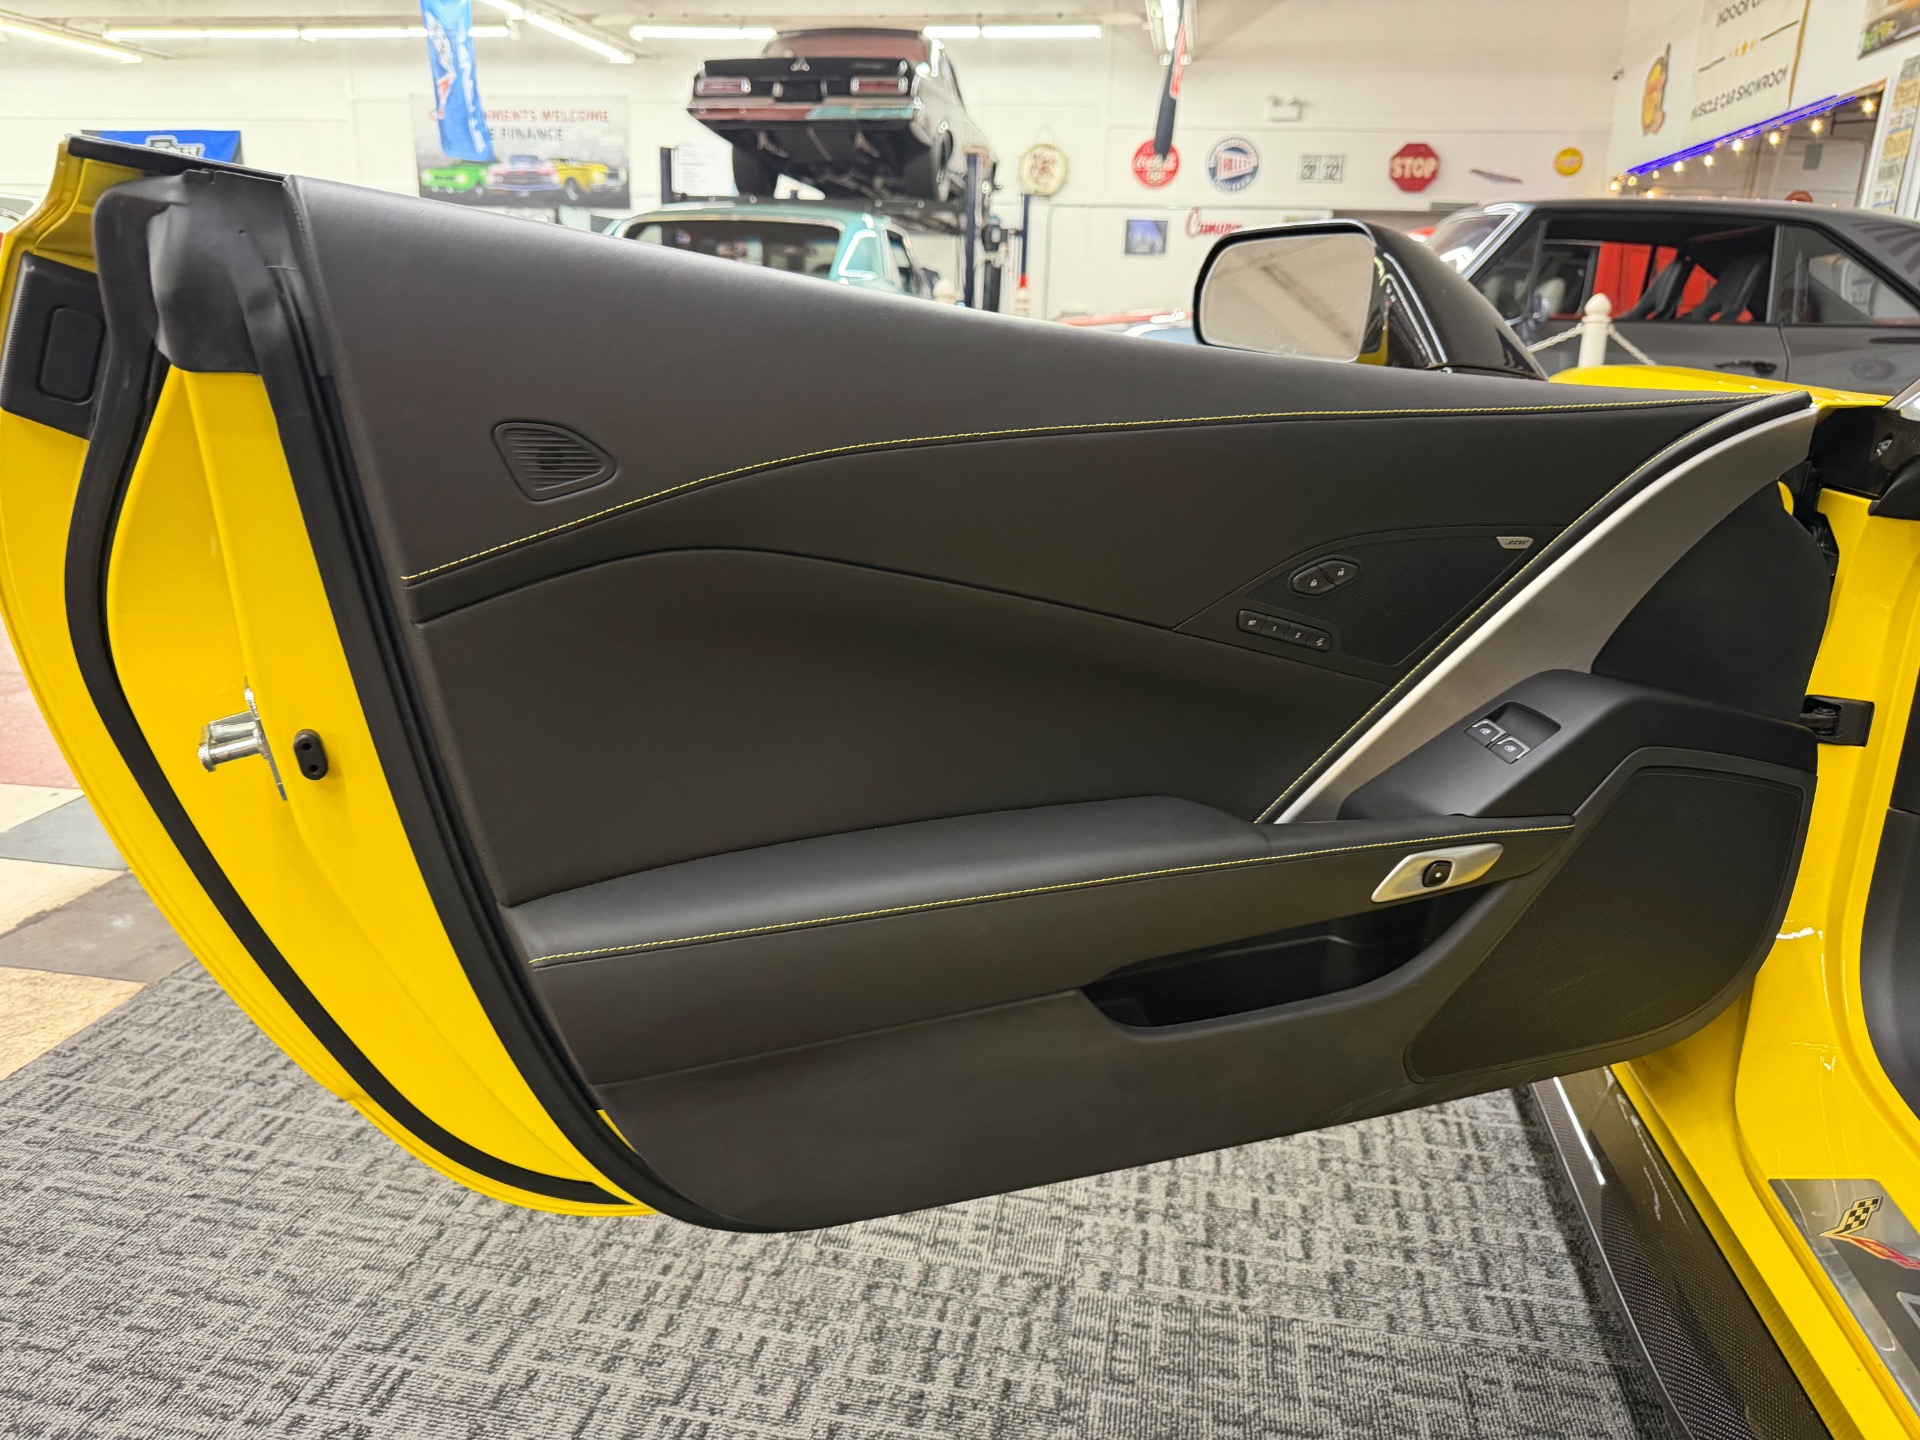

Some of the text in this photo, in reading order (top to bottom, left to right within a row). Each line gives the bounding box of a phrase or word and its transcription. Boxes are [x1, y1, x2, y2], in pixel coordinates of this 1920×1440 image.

[1720, 89, 1736, 108] CAR
[542, 109, 609, 122] WELCOME
[501, 127, 564, 141] FINANCE
[1391, 156, 1436, 178] STOP
